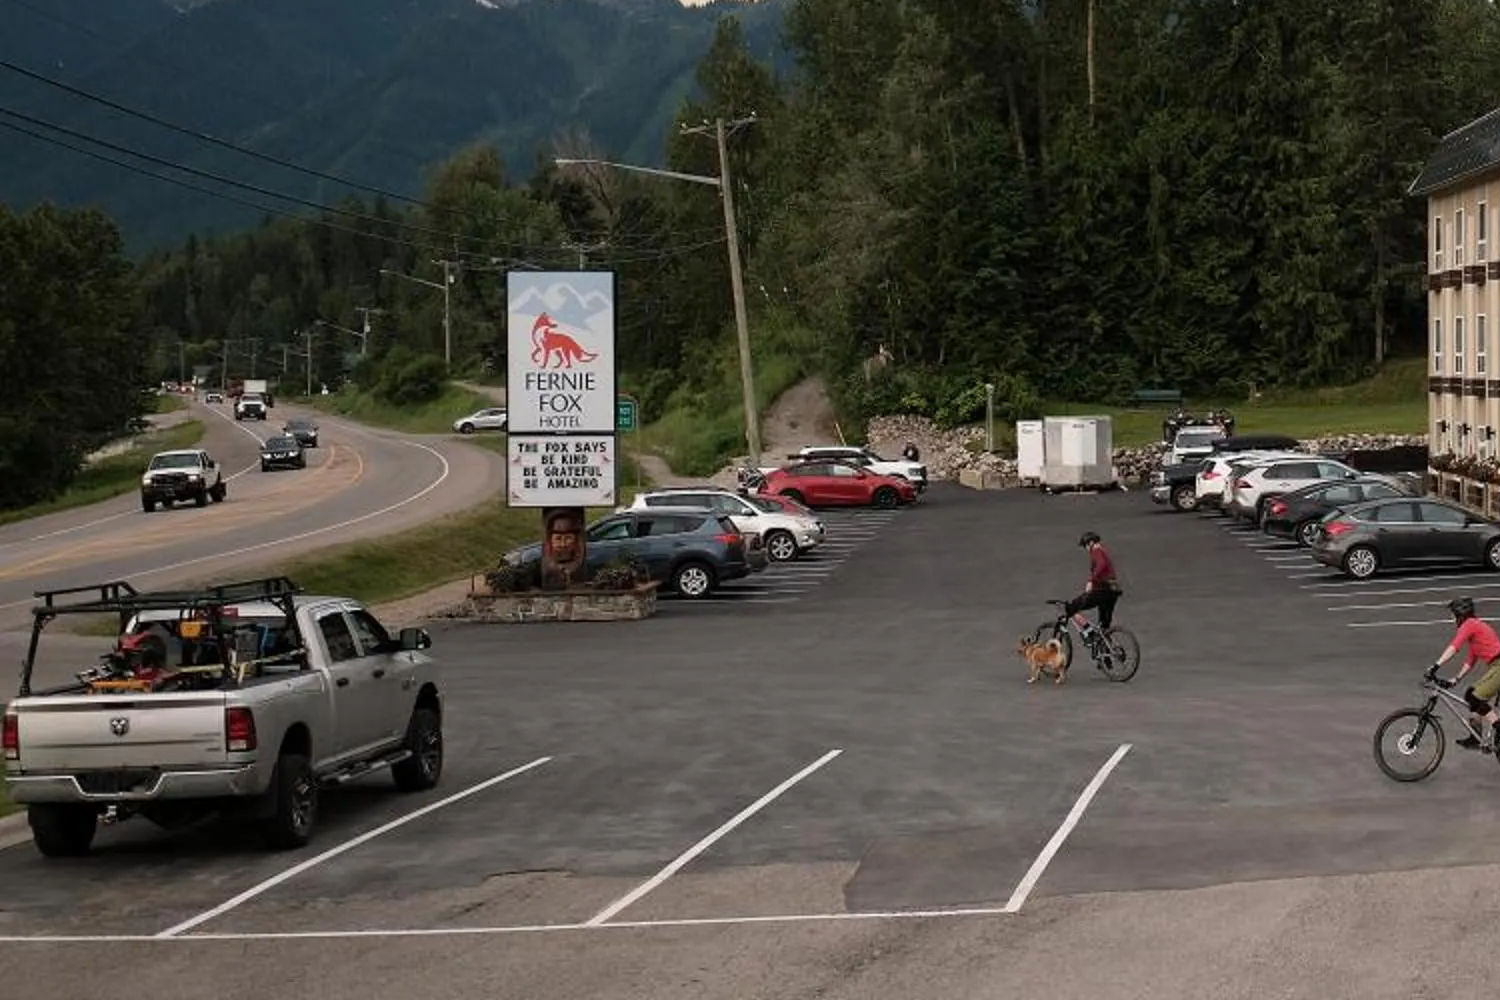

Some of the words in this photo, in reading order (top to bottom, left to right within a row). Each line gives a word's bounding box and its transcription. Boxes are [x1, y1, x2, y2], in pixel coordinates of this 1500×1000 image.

[525, 371, 596, 391] FERNIE
[539, 393, 583, 413] FOX
[539, 415, 581, 428] HOTEL
[518, 442, 538, 453] THE
[545, 441, 569, 453] FOX
[575, 441, 607, 453] SAYS
[541, 454, 555, 465] BE
[561, 454, 589, 465] KIND
[523, 466, 537, 477] BE
[543, 466, 603, 477] GRATEFUL
[523, 478, 539, 489] BE
[547, 478, 599, 489] AMAZING
